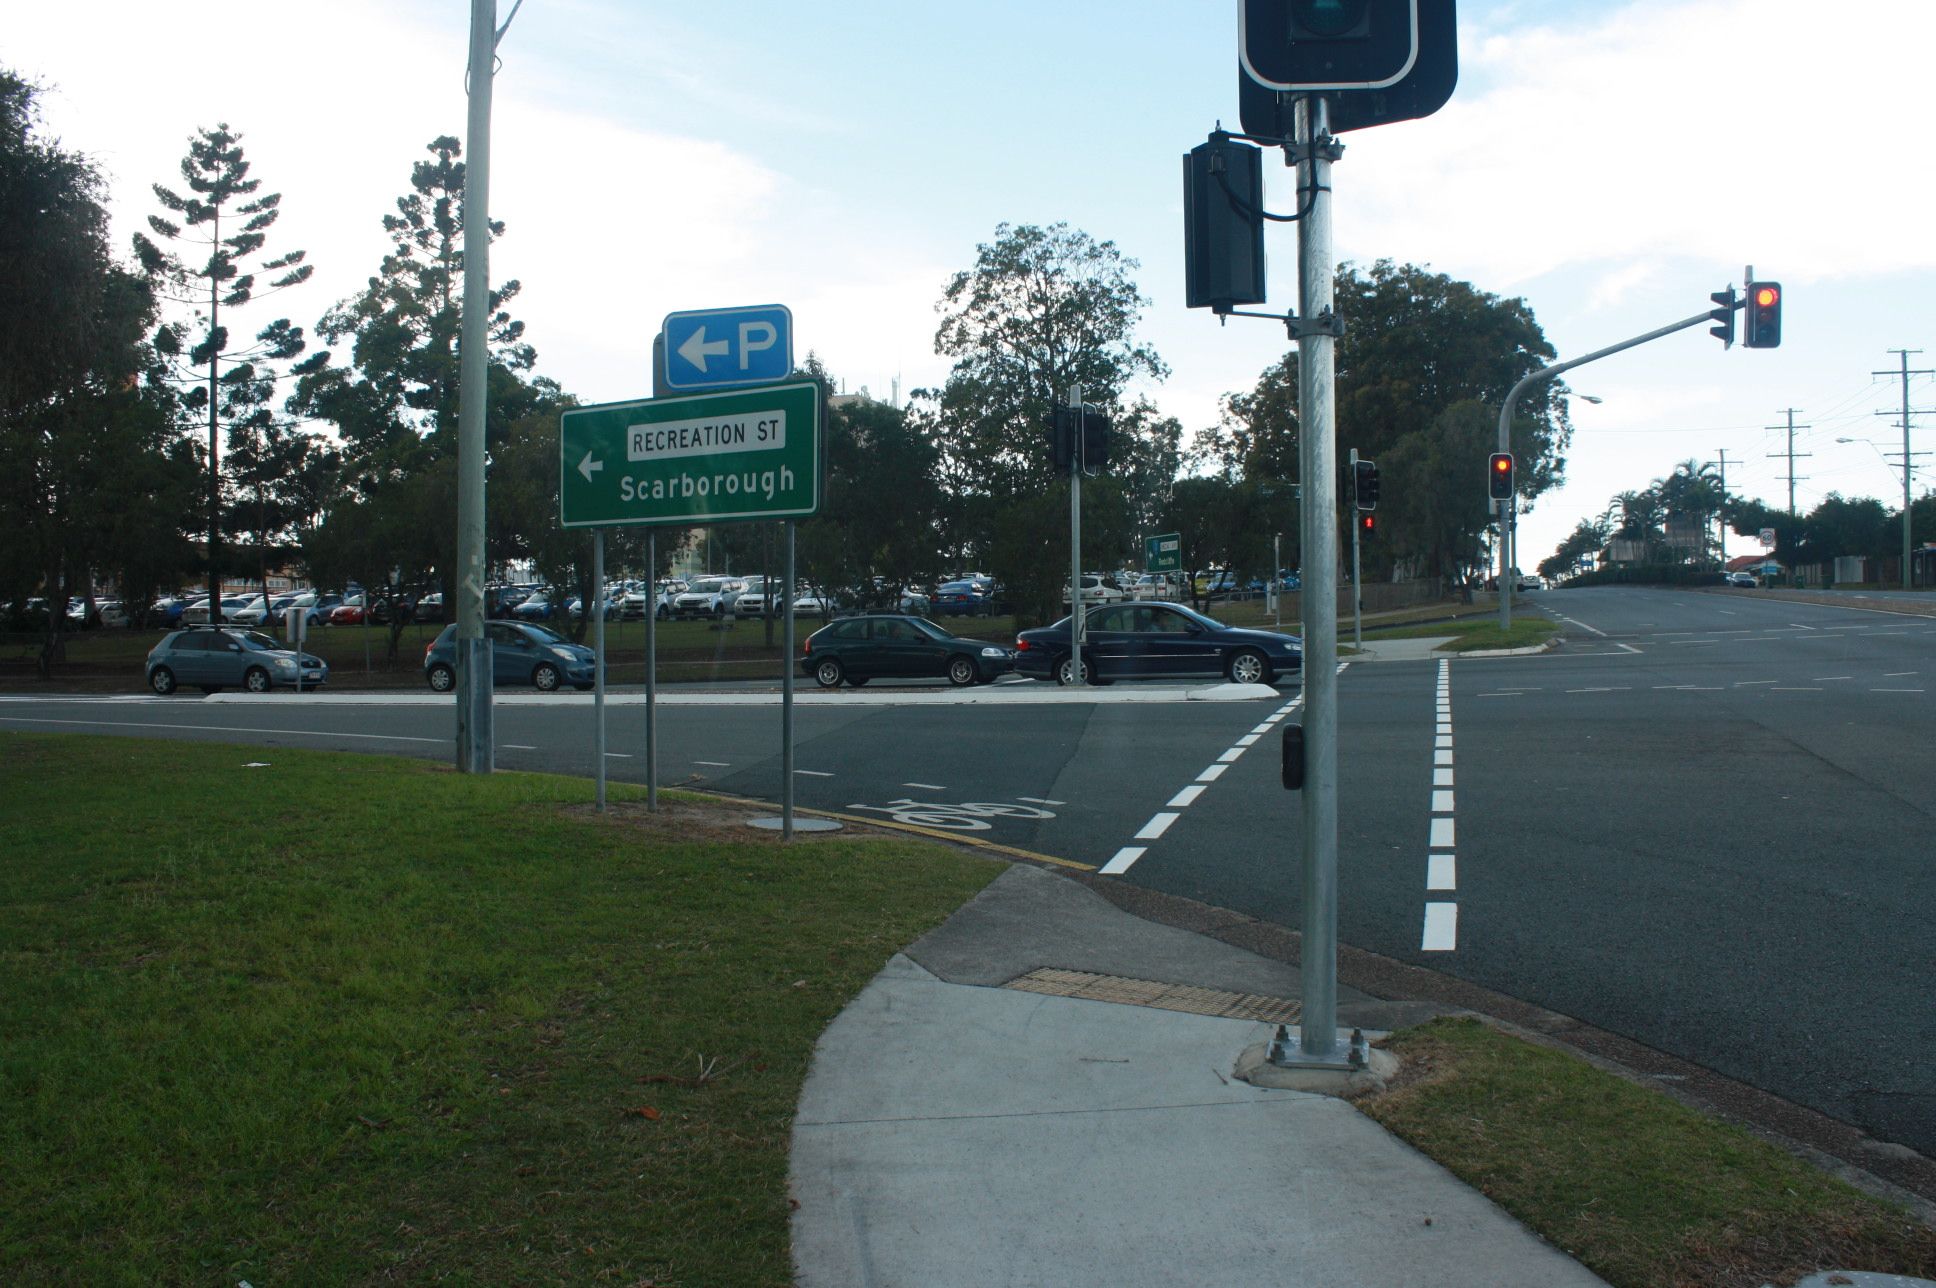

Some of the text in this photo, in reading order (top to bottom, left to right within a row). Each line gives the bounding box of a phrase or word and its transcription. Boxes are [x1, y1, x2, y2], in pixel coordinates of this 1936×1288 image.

[738, 321, 778, 370] P
[633, 419, 779, 453] RECREATION ST
[620, 463, 794, 502] Scarborough
